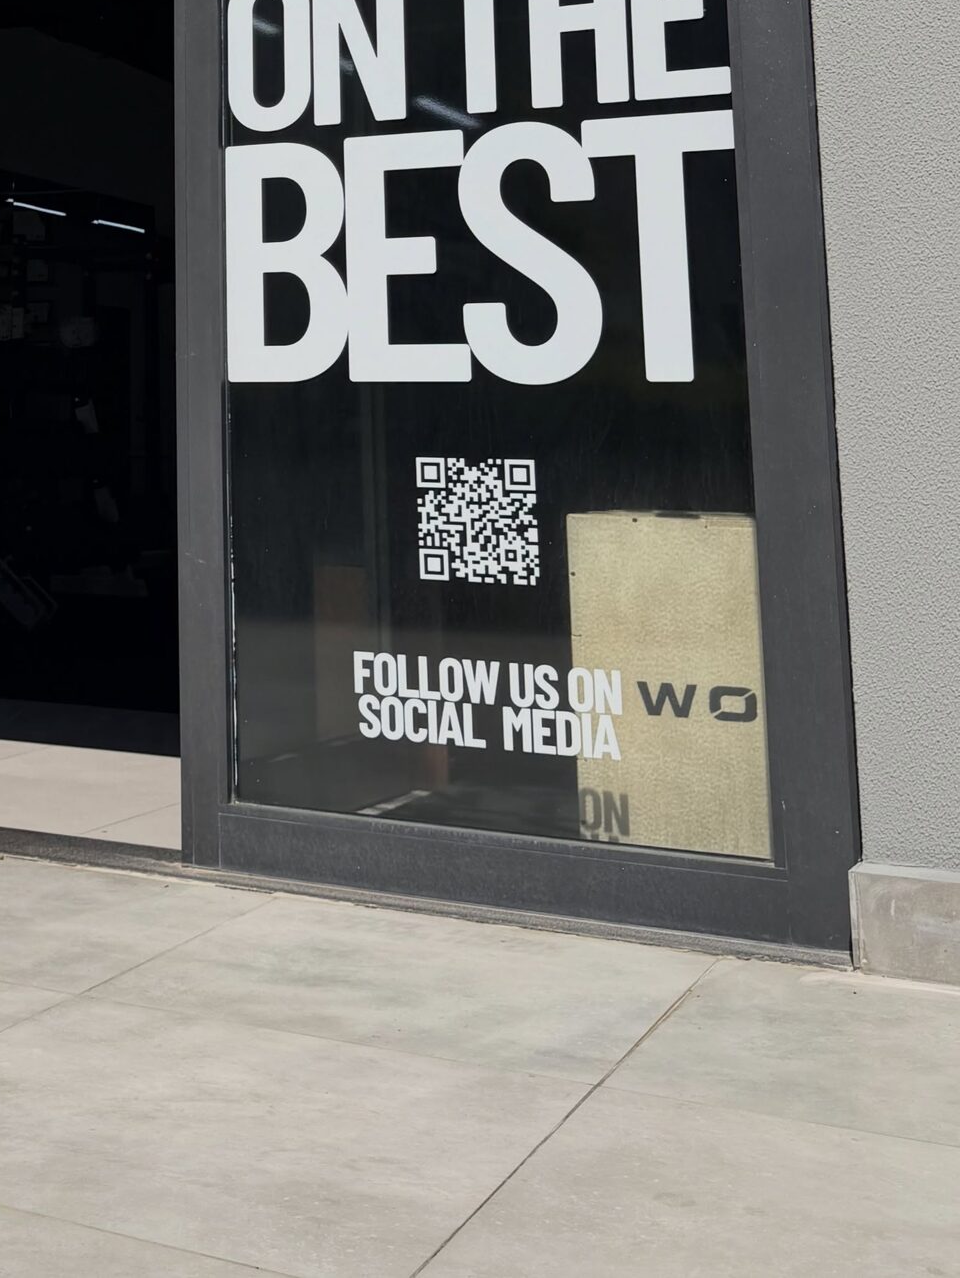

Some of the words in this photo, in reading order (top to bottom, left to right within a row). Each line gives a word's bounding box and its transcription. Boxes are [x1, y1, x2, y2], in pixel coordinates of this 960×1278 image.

[225, 109, 736, 386] BEST
[353, 650, 500, 705] FOLLOW
[509, 662, 560, 710] US
[568, 667, 623, 715] ON
[358, 694, 487, 749] SOCIAL
[502, 706, 622, 761] MEDIA
